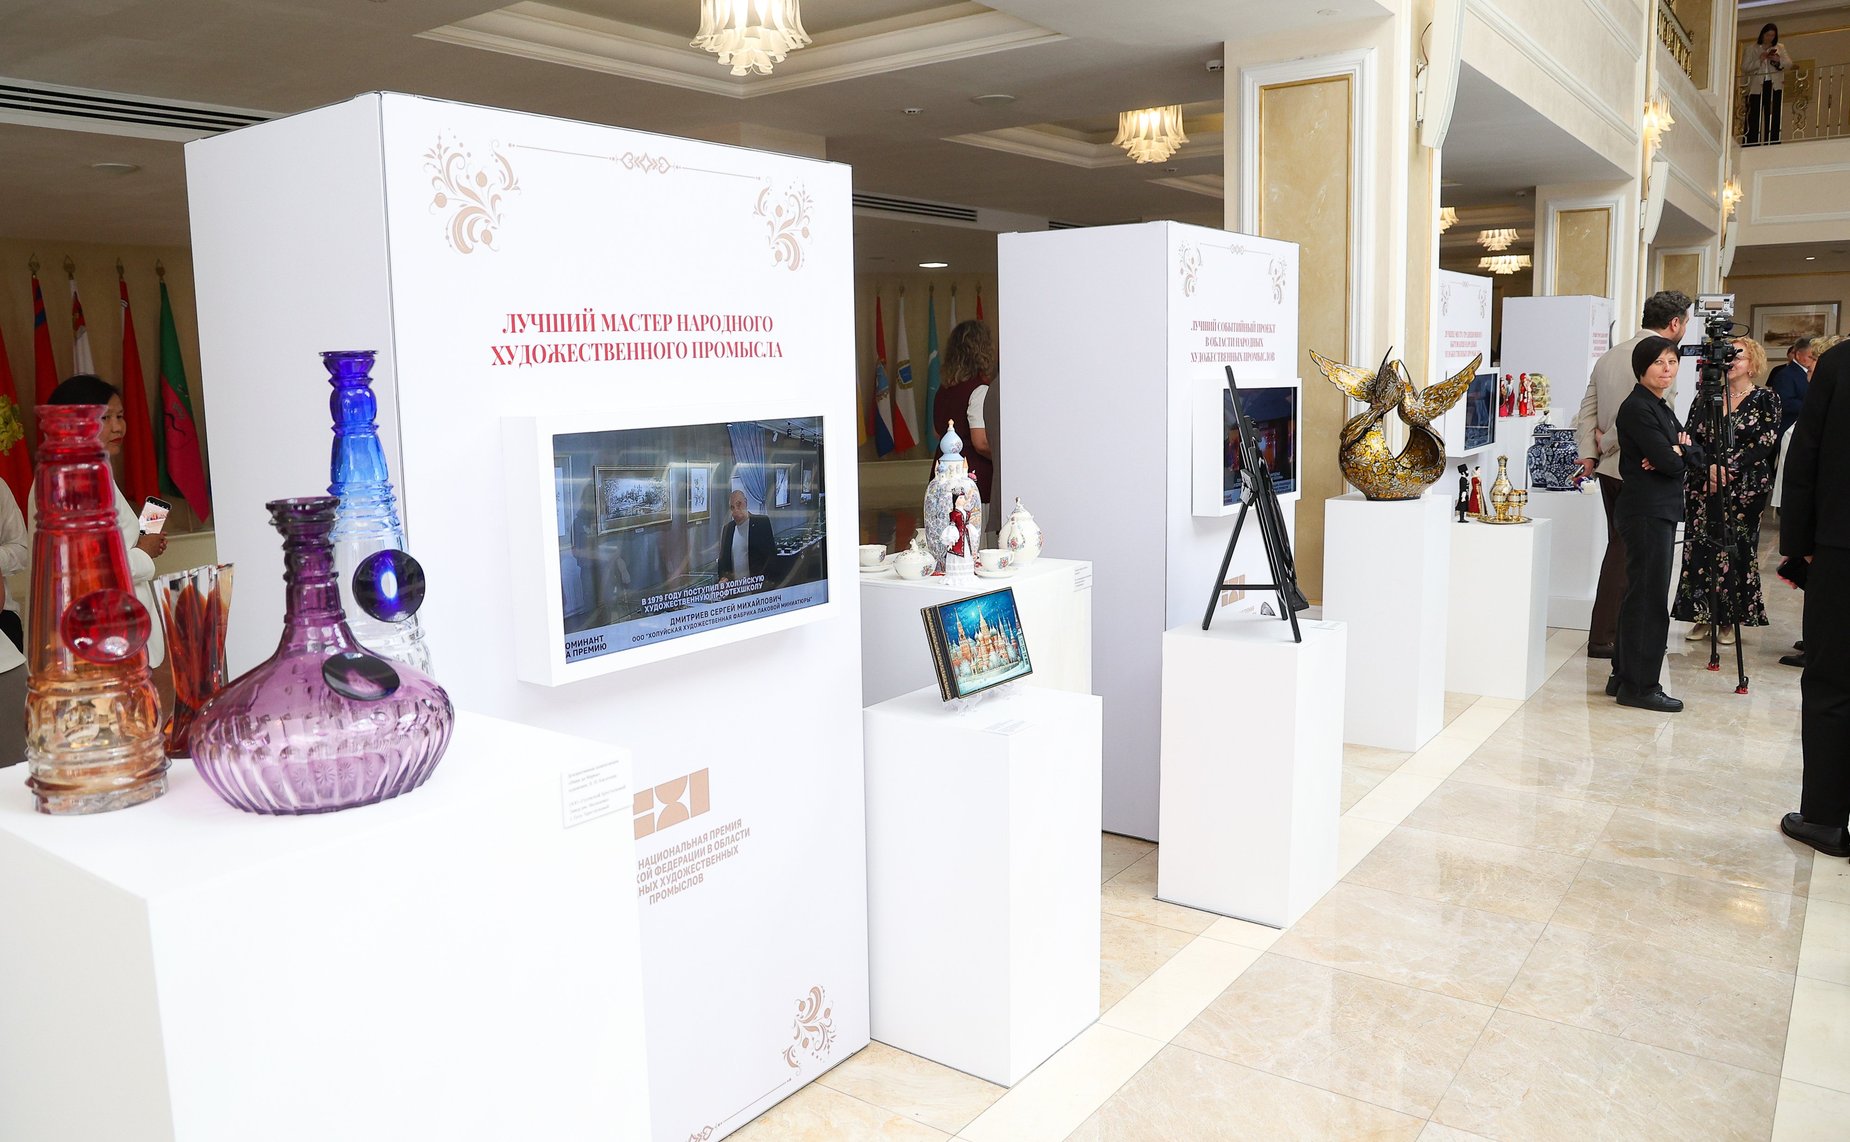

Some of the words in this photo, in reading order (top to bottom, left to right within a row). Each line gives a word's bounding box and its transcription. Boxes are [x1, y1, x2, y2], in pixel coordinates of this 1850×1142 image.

[502, 308, 596, 334] ЛУЧШИЙ
[601, 313, 673, 333] МАСТЕР
[677, 314, 773, 335] НАРОДНОГО
[1190, 318, 1217, 332] ЛУЧШИЙ
[1257, 323, 1276, 334] ПРОЕКТ
[491, 340, 688, 369] ХУДОЖЕСТВЕННОГО
[692, 341, 783, 359] ПРОМЫСЛА
[1235, 337, 1264, 348] НАРОДНЫХ
[644, 593, 710, 613] ХУДОЖЕСТВЕННУЮ
[711, 582, 763, 598] ПРОФТЕХШКОЛУ
[647, 596, 663, 605] 1979
[665, 591, 682, 601] ГОДУ
[683, 584, 719, 598] ПОСТУПИЛ
[725, 574, 765, 589] ХОЛУЙСКУЮ
[670, 611, 709, 626] ДМИТРИЕВ
[710, 605, 736, 617] СЕРГЕЙ
[736, 594, 782, 611] МИХАЙЛОВИЧ
[632, 634, 645, 643] ООО
[683, 615, 732, 631] ХУДОЖЕСТВЕННАЯ
[732, 609, 757, 619] ФАБРИКА
[573, 643, 607, 657] ПРЕМИЮ
[638, 833, 708, 870] НАЦИОНАЛЬНАЯ
[710, 818, 742, 840] ПРЕМИЯ
[654, 848, 706, 876] ФЕДЕРАЦИИ
[707, 844, 713, 854] В
[714, 827, 750, 851] ОБЛАСТИ
[660, 844, 739, 888] ХУДОЖЕСТВЕННЫХ
[649, 873, 704, 905] ПРОМЫСЛОВ
